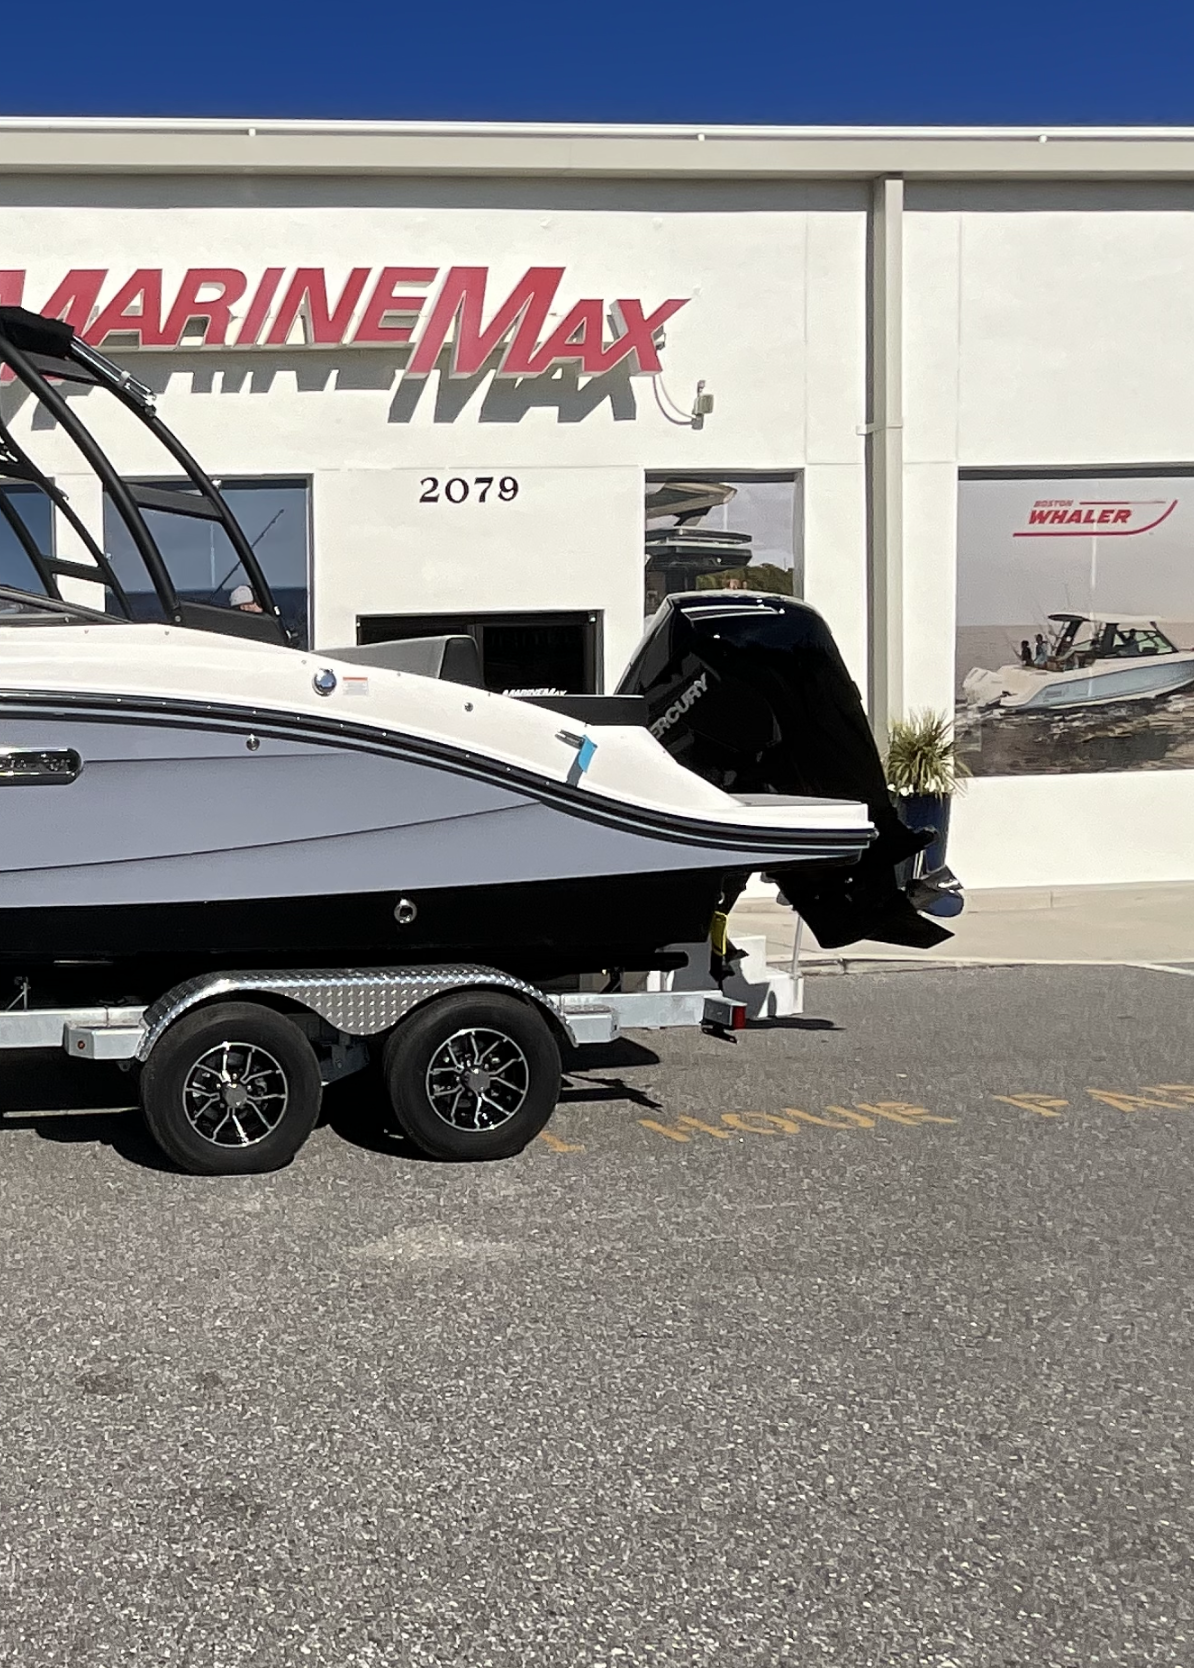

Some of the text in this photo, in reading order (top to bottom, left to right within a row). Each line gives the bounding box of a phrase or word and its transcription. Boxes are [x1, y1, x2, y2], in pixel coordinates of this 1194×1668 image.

[419, 476, 519, 504] 2079
[1034, 500, 1073, 508] BOSTON
[1028, 510, 1132, 524] WHALER
[649, 672, 707, 739] ERCURY
[637, 1102, 957, 1143] HOUR
